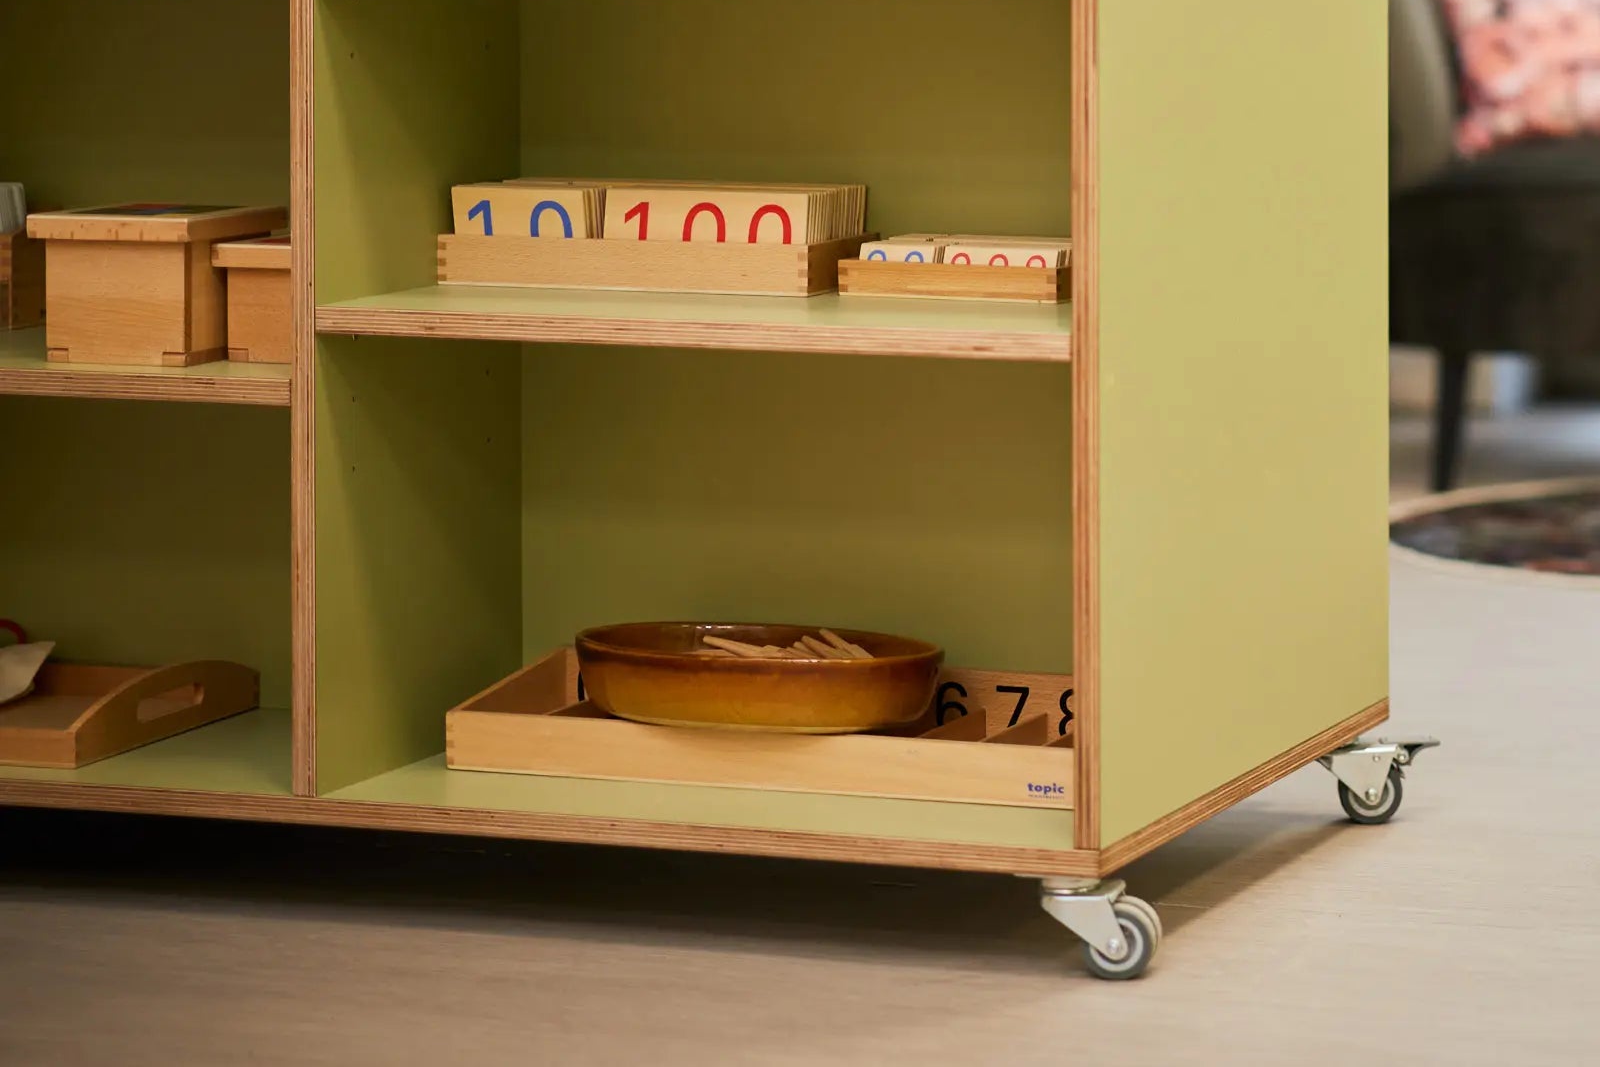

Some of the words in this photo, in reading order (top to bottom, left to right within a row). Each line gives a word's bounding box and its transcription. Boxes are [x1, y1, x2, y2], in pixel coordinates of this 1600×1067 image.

[468, 199, 574, 239] 10
[624, 201, 792, 245] 100
[936, 681, 968, 727] 6
[996, 685, 1030, 728] 7
[1027, 782, 1065, 795] topic
